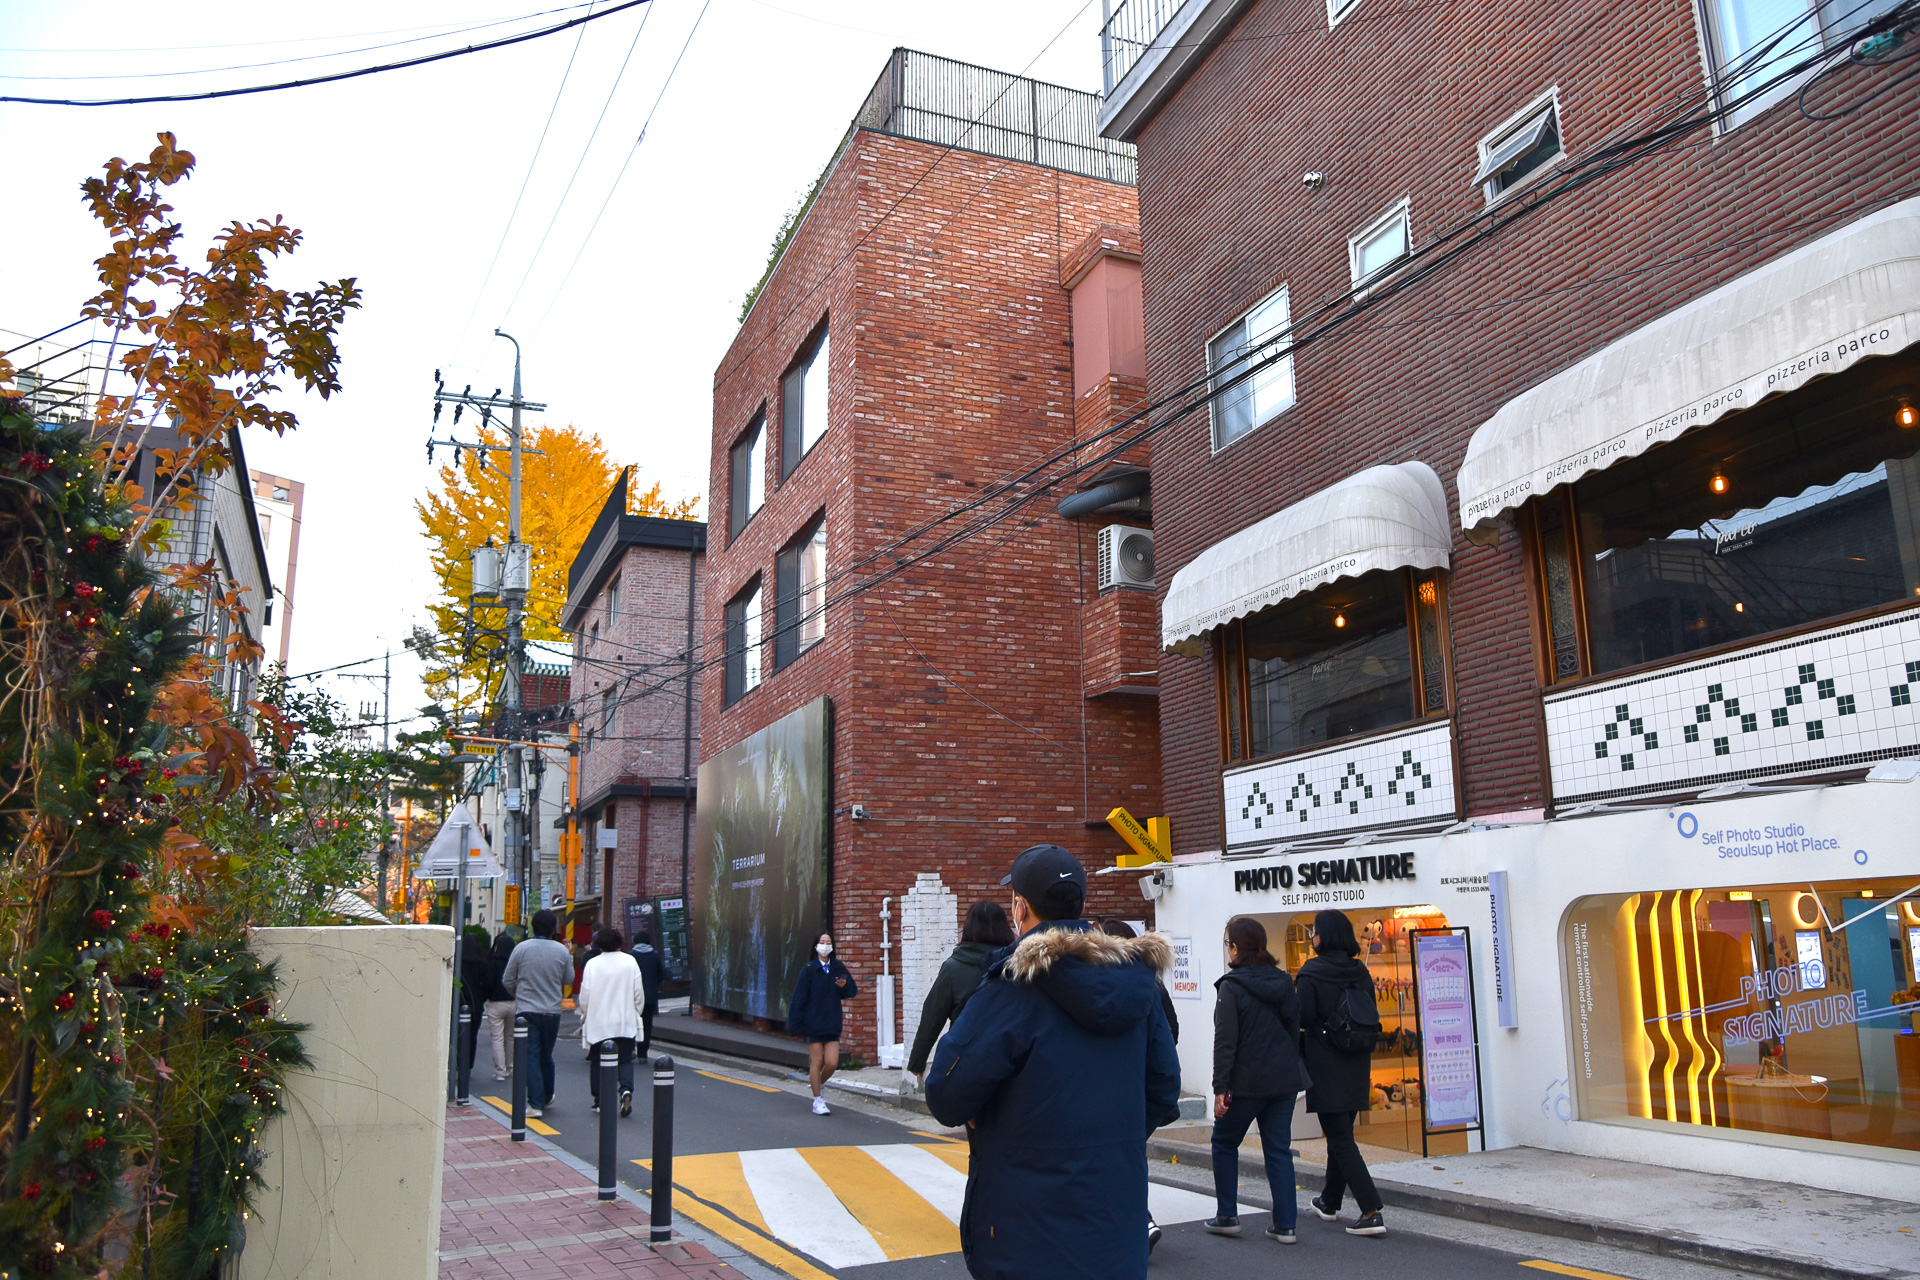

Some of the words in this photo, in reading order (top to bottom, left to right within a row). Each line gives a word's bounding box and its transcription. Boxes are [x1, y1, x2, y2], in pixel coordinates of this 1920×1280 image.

[1767, 351, 1830, 387] pizzeria
[1837, 329, 1890, 359] parco
[1646, 406, 1698, 440] pizzeria
[1703, 387, 1743, 416] parco
[1546, 454, 1589, 482] pizzeria
[1592, 438, 1627, 471] parco
[1467, 496, 1500, 519] pizzeria
[1503, 479, 1532, 505] parco
[1715, 521, 1759, 555] parco
[1300, 566, 1328, 586] pizzeria
[1330, 556, 1356, 577] parco
[1244, 592, 1269, 609] pizzeria
[1269, 582, 1290, 601] parco
[1177, 624, 1191, 636] parco
[1197, 611, 1218, 627] pizzeria
[1219, 605, 1236, 619] parco
[1118, 812, 1139, 835] PHOTO
[1702, 830, 1724, 846] Self
[1726, 826, 1762, 844] Photo
[1764, 822, 1805, 840] Studio
[732, 852, 766, 871] TERRARIUM
[1718, 842, 1773, 860] Seoulsup
[1776, 838, 1798, 855] Hot
[1801, 836, 1841, 852] Place.
[1234, 864, 1293, 893] PHOTO
[1297, 851, 1416, 887] SIGNATURE
[1281, 893, 1301, 906] SELF
[1303, 890, 1330, 904] PHOTO
[1332, 888, 1365, 903] STUDIO
[1490, 894, 1498, 934] PHOTO
[1174, 945, 1188, 954] MAKE
[1573, 922, 1581, 955] remote
[1174, 969, 1189, 979] OWN
[1174, 982, 1198, 991] MEMORY
[1493, 937, 1503, 1003] SIGNATURE
[1576, 956, 1586, 1002] controlled
[1584, 961, 1593, 1012] nationwide
[1740, 958, 1827, 1001] PHOTO
[1580, 1003, 1589, 1050] self-photo
[1723, 989, 1868, 1047] SIGNATURE
[1584, 1051, 1592, 1079] booth
